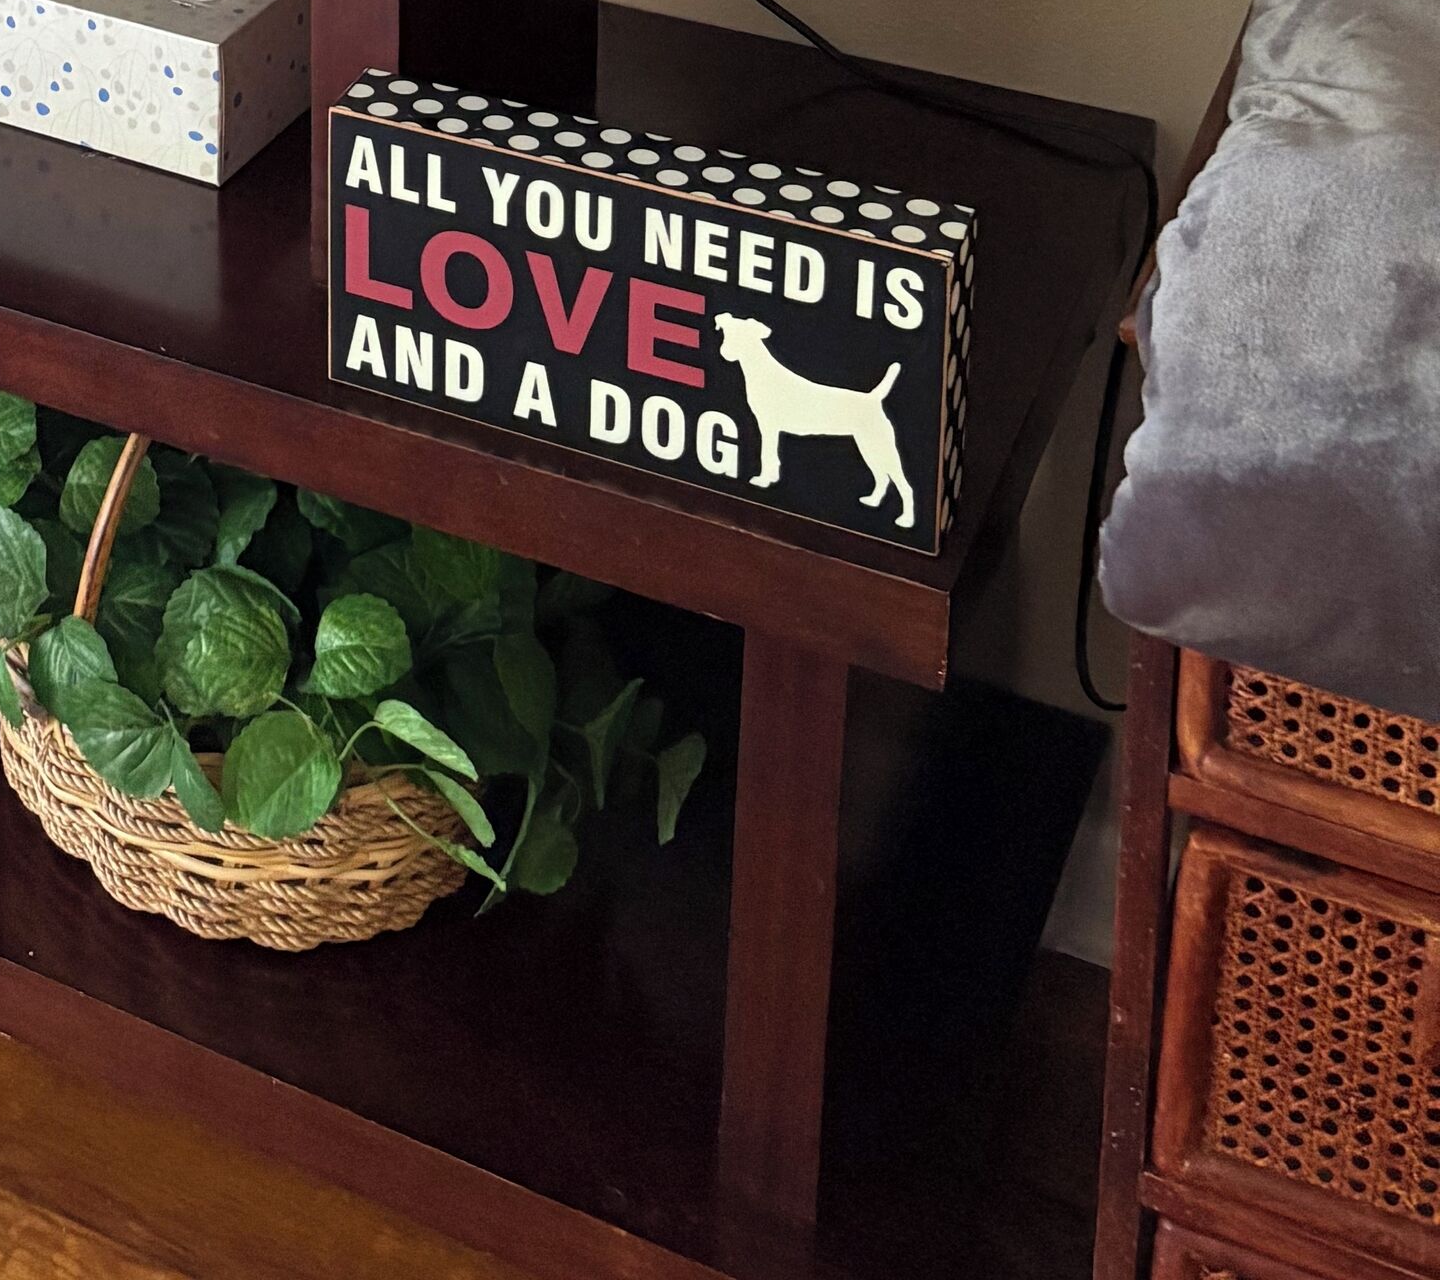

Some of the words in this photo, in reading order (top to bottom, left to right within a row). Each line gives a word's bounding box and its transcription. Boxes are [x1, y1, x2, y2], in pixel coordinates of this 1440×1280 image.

[345, 135, 456, 214] ALL
[481, 166, 613, 252] YOU
[644, 207, 826, 304] NEED
[856, 259, 925, 330] IS
[345, 203, 706, 388] LOVE
[345, 313, 484, 403] AND
[513, 360, 557, 428] A
[589, 378, 739, 479] DOG
